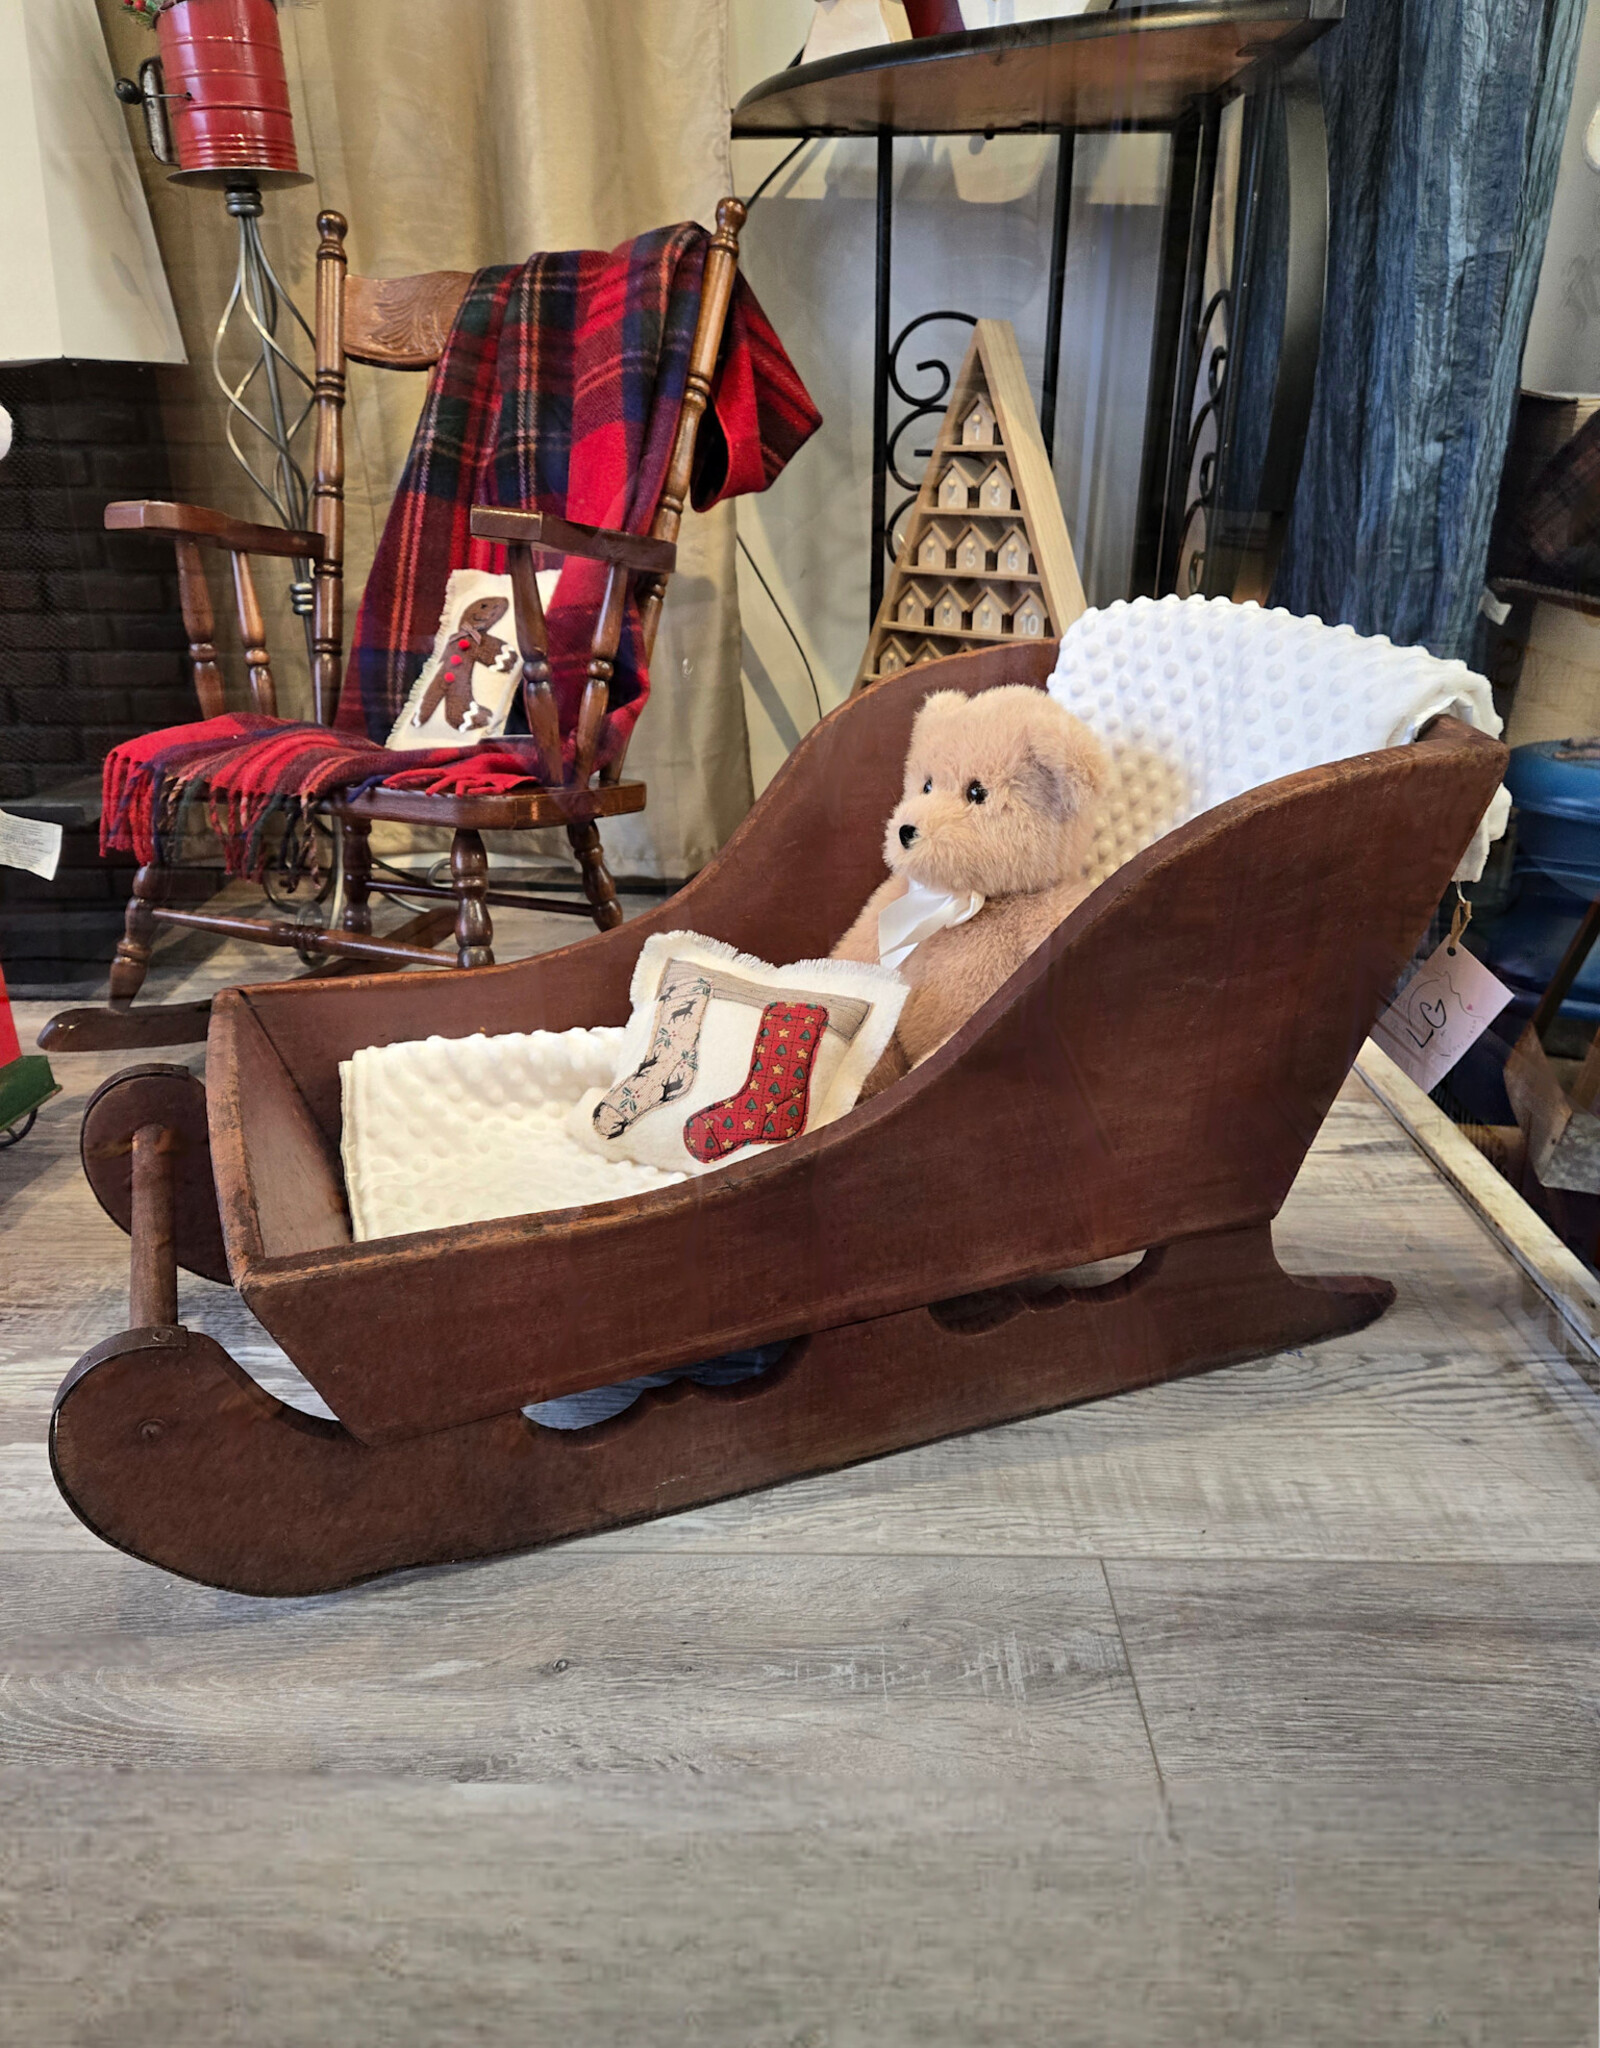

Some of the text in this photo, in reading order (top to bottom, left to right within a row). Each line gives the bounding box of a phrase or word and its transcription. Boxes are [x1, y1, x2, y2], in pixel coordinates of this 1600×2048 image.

[973, 422, 981, 441] 1
[991, 488, 1001, 506] 3
[965, 551, 976, 568] 5
[1007, 551, 1018, 570] 6
[906, 604, 915, 620] 7
[981, 609, 992, 629] 9
[1020, 614, 1039, 636] 10
